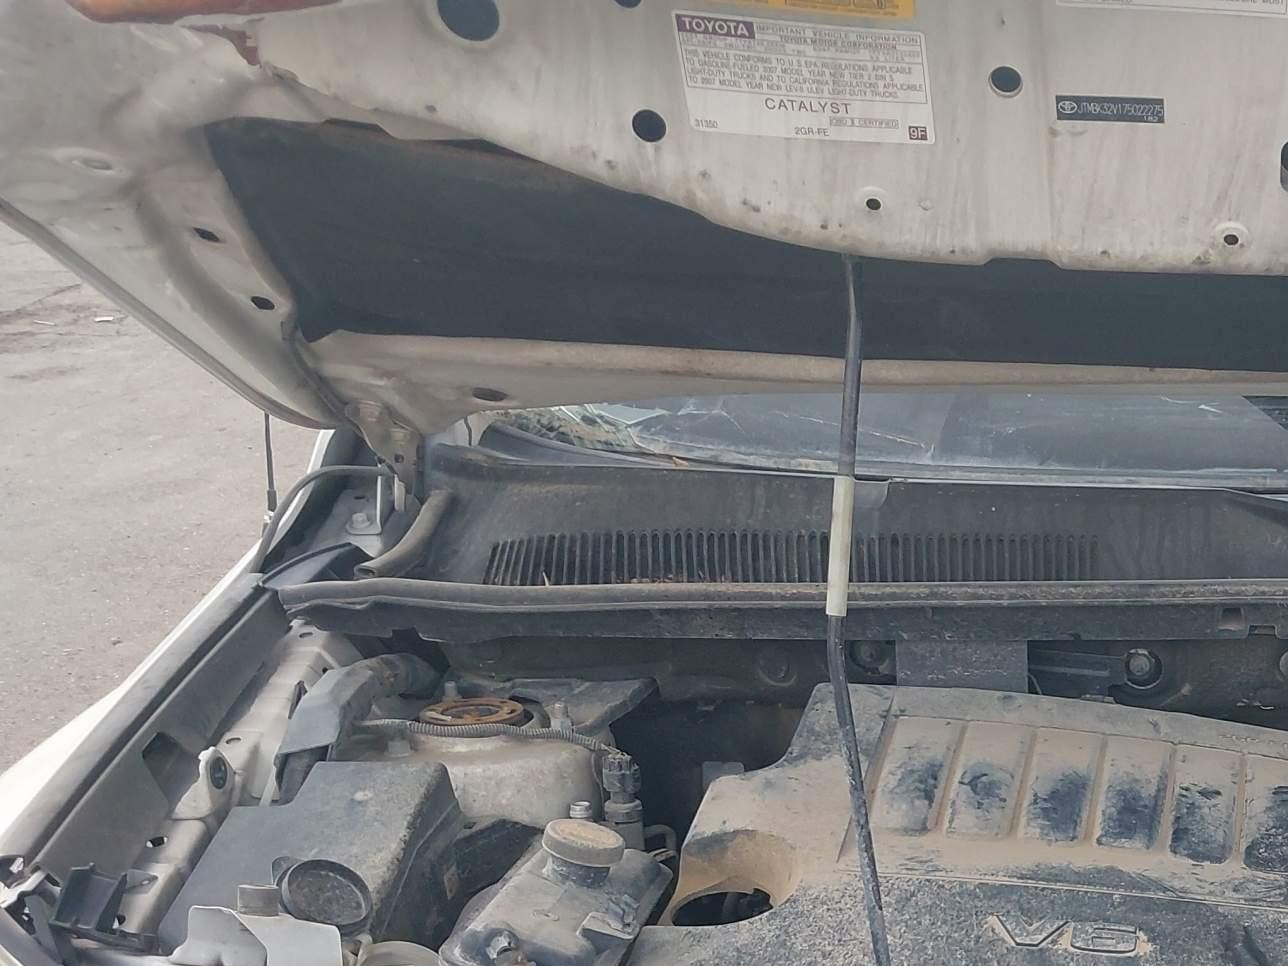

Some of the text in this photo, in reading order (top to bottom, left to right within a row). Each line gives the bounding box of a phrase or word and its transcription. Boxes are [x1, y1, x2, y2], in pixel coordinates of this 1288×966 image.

[681, 17, 750, 37] TOYOTA
[764, 97, 852, 114] CATALYST
[794, 126, 831, 137] 2GR-FE
[910, 127, 926, 139] 9F
[988, 912, 1139, 956] V6
